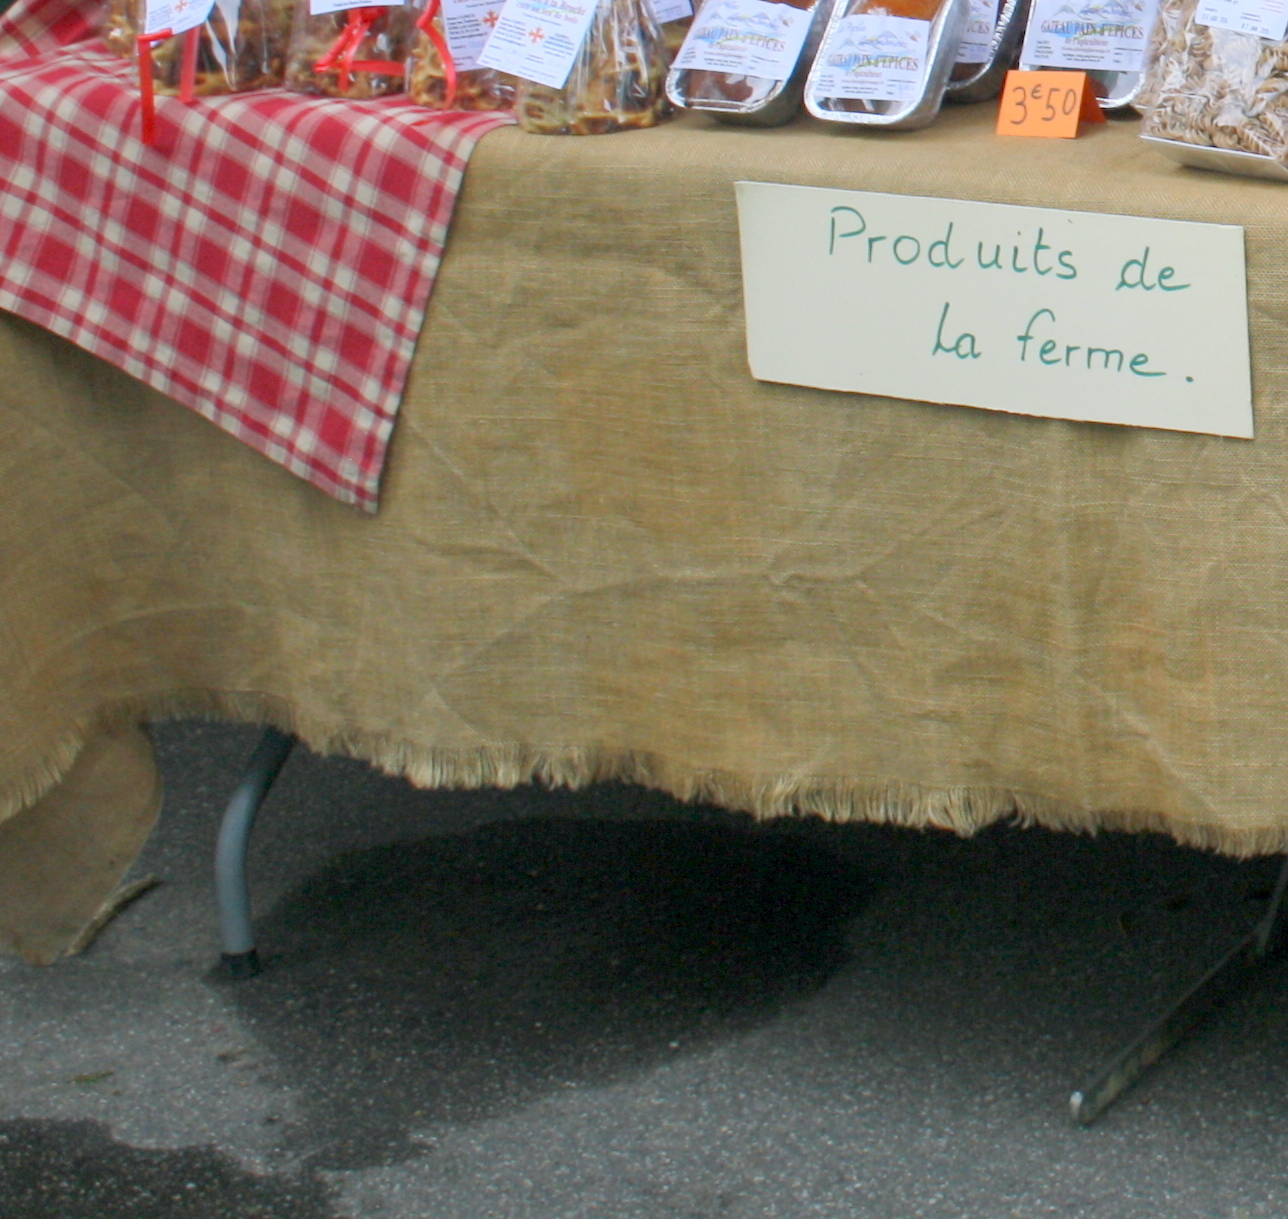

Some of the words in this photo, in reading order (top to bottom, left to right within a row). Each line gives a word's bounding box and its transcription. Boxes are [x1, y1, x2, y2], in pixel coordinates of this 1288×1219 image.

[1074, 21, 1099, 35] PAIN
[829, 205, 1078, 280] Produits
[1115, 246, 1192, 291] de
